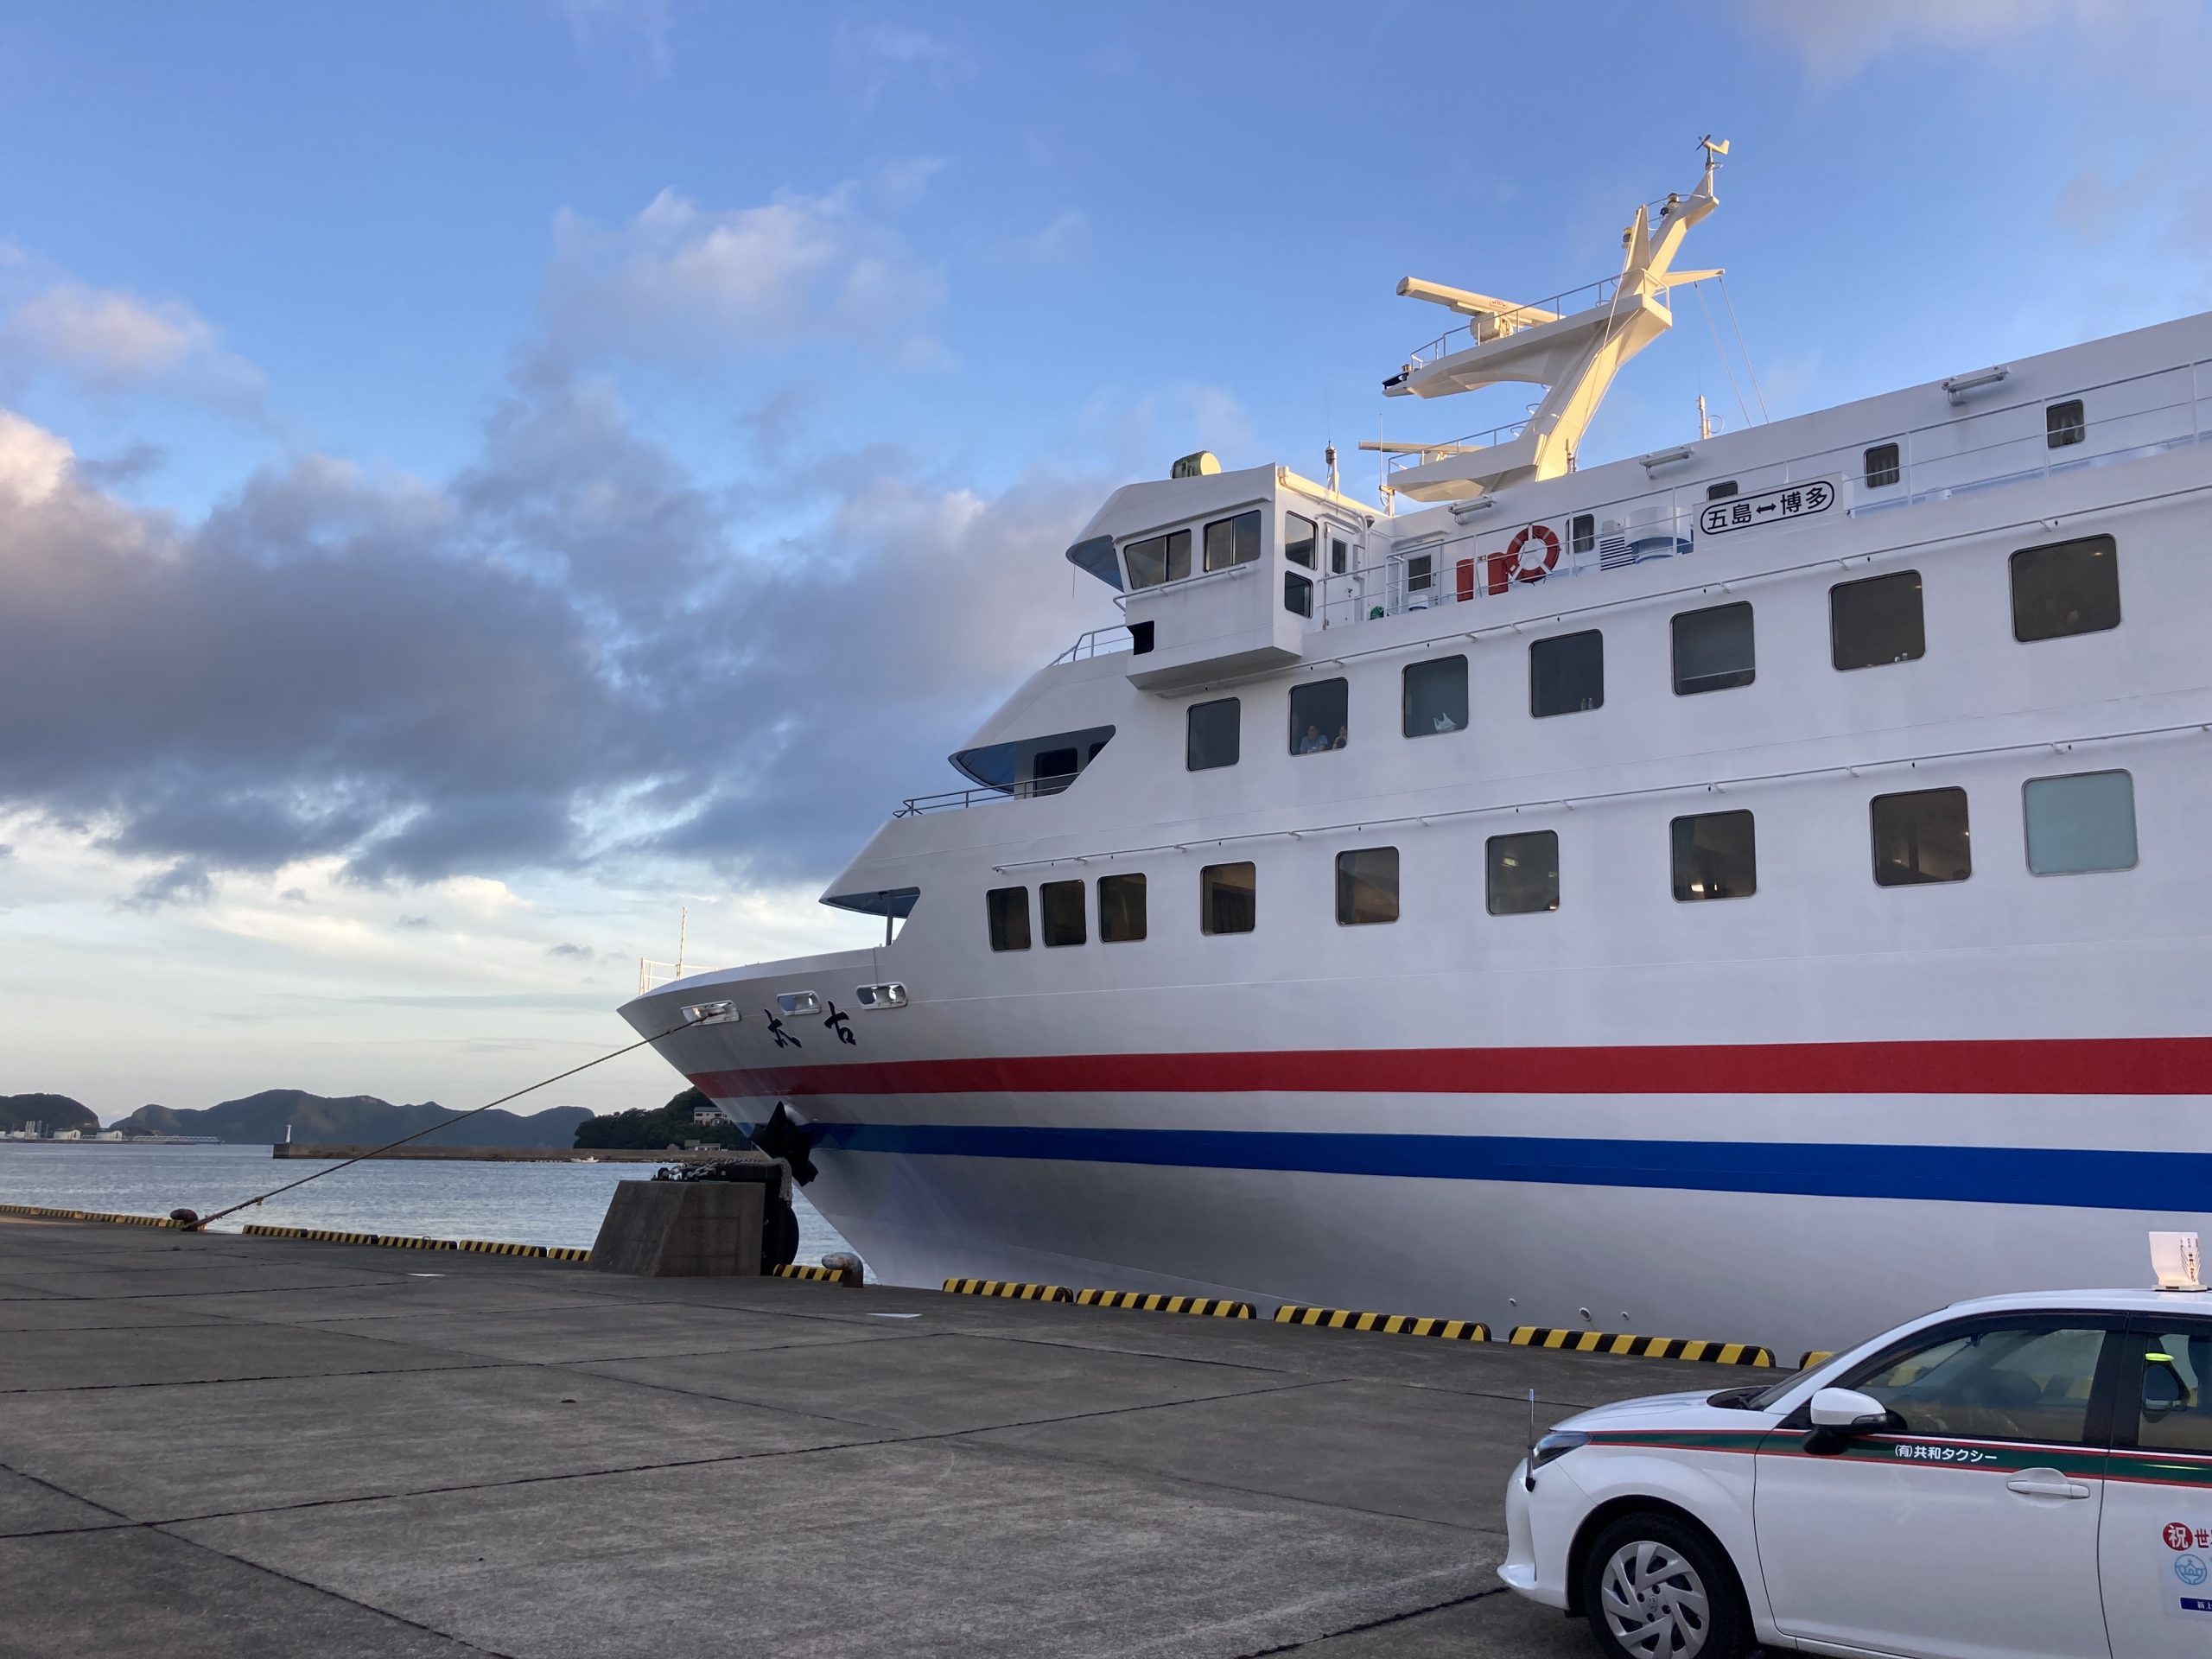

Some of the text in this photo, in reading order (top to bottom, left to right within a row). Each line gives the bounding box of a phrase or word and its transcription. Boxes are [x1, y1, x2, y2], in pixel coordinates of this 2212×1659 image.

[1707, 486, 1828, 531] 五島 博多
[1895, 1444, 1998, 1463] (有)共和タクシー
